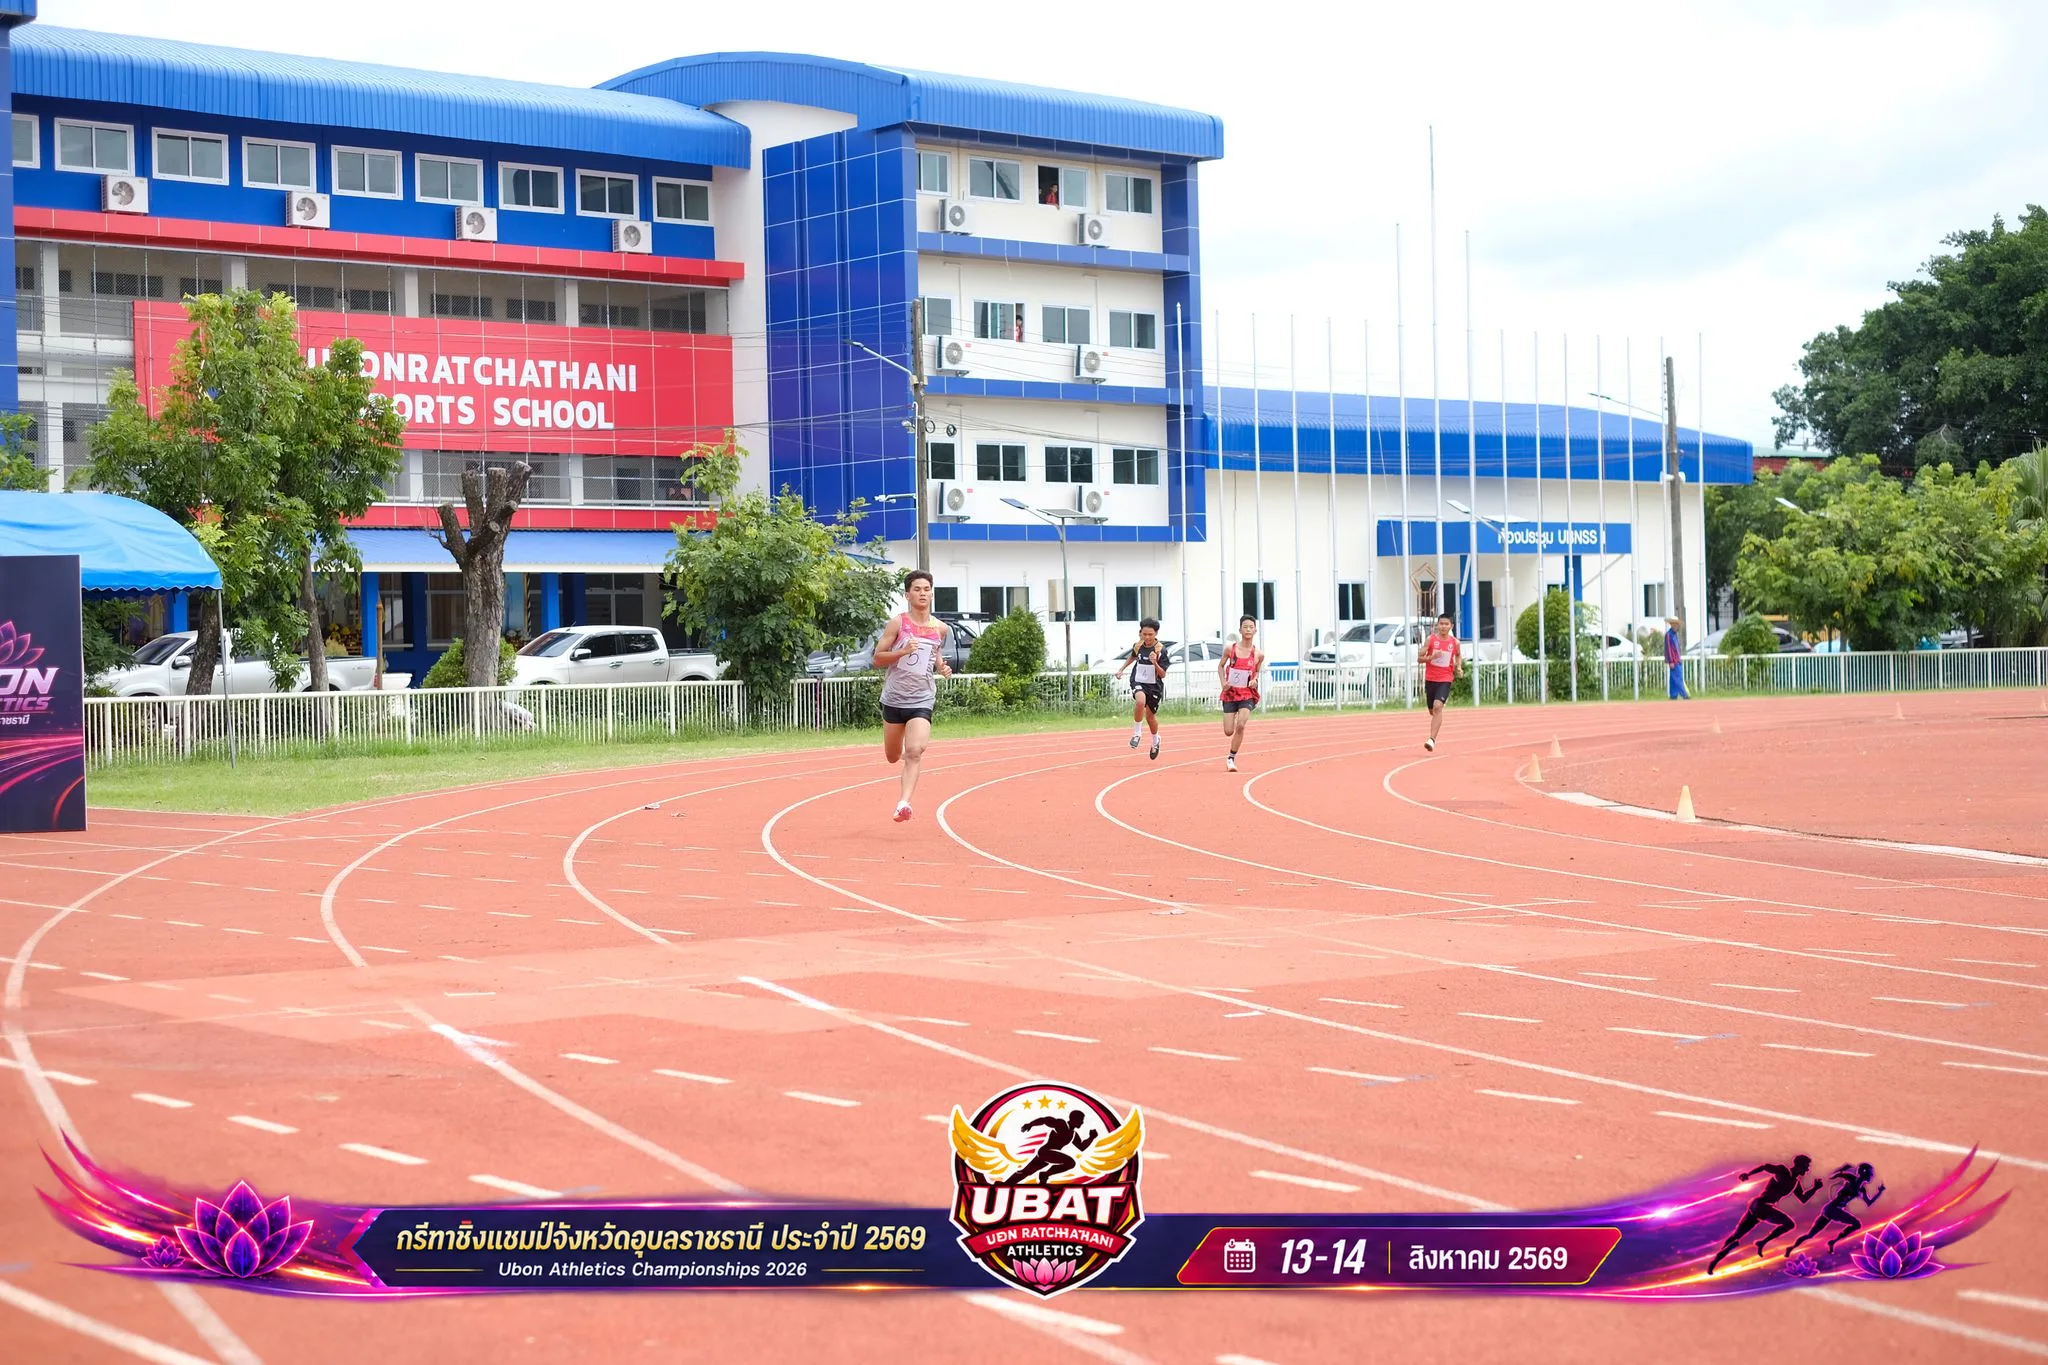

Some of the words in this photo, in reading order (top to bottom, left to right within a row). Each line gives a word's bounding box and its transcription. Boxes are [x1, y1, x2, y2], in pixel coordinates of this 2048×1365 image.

[307, 346, 637, 392] UONRATCHATHANI
[360, 393, 475, 426] ORTS
[493, 397, 614, 430] SCHOOL
[906, 647, 925, 667] 5
[0, 696, 54, 712] TICS
